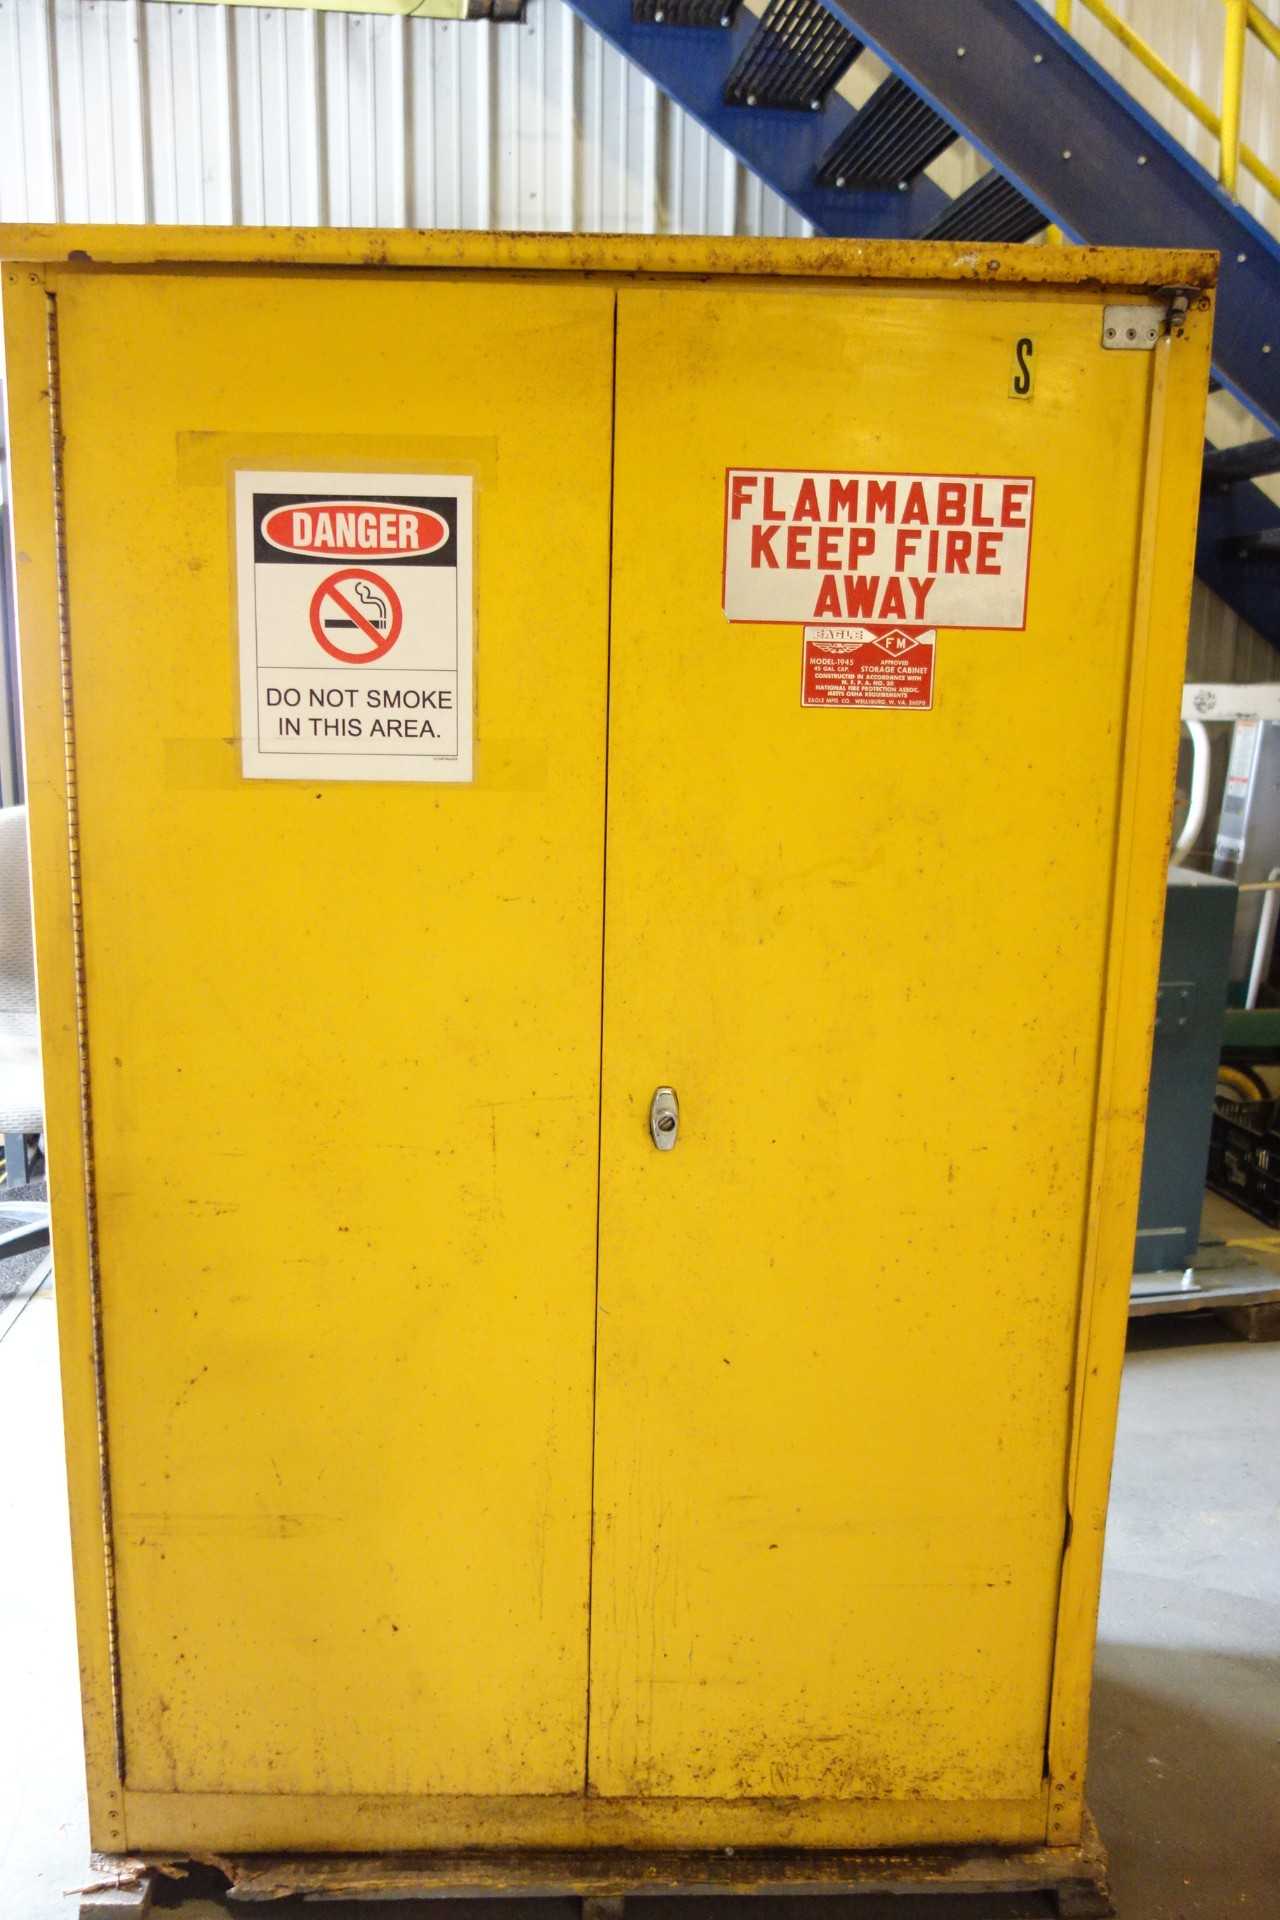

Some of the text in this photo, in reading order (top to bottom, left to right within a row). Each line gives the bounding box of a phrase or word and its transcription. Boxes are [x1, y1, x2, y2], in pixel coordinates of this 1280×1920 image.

[1014, 338, 1033, 394] S
[731, 476, 1028, 528] FLAMMABLE
[292, 512, 420, 550] DANGER
[751, 525, 1003, 575] KEEP FIRE
[813, 575, 936, 620] AWAY
[816, 630, 863, 641] EAGLE
[866, 674, 907, 682] ACCORDANCE
[266, 688, 453, 709] DO NOT SMOKE
[279, 718, 441, 738] IN THIS AREA.
